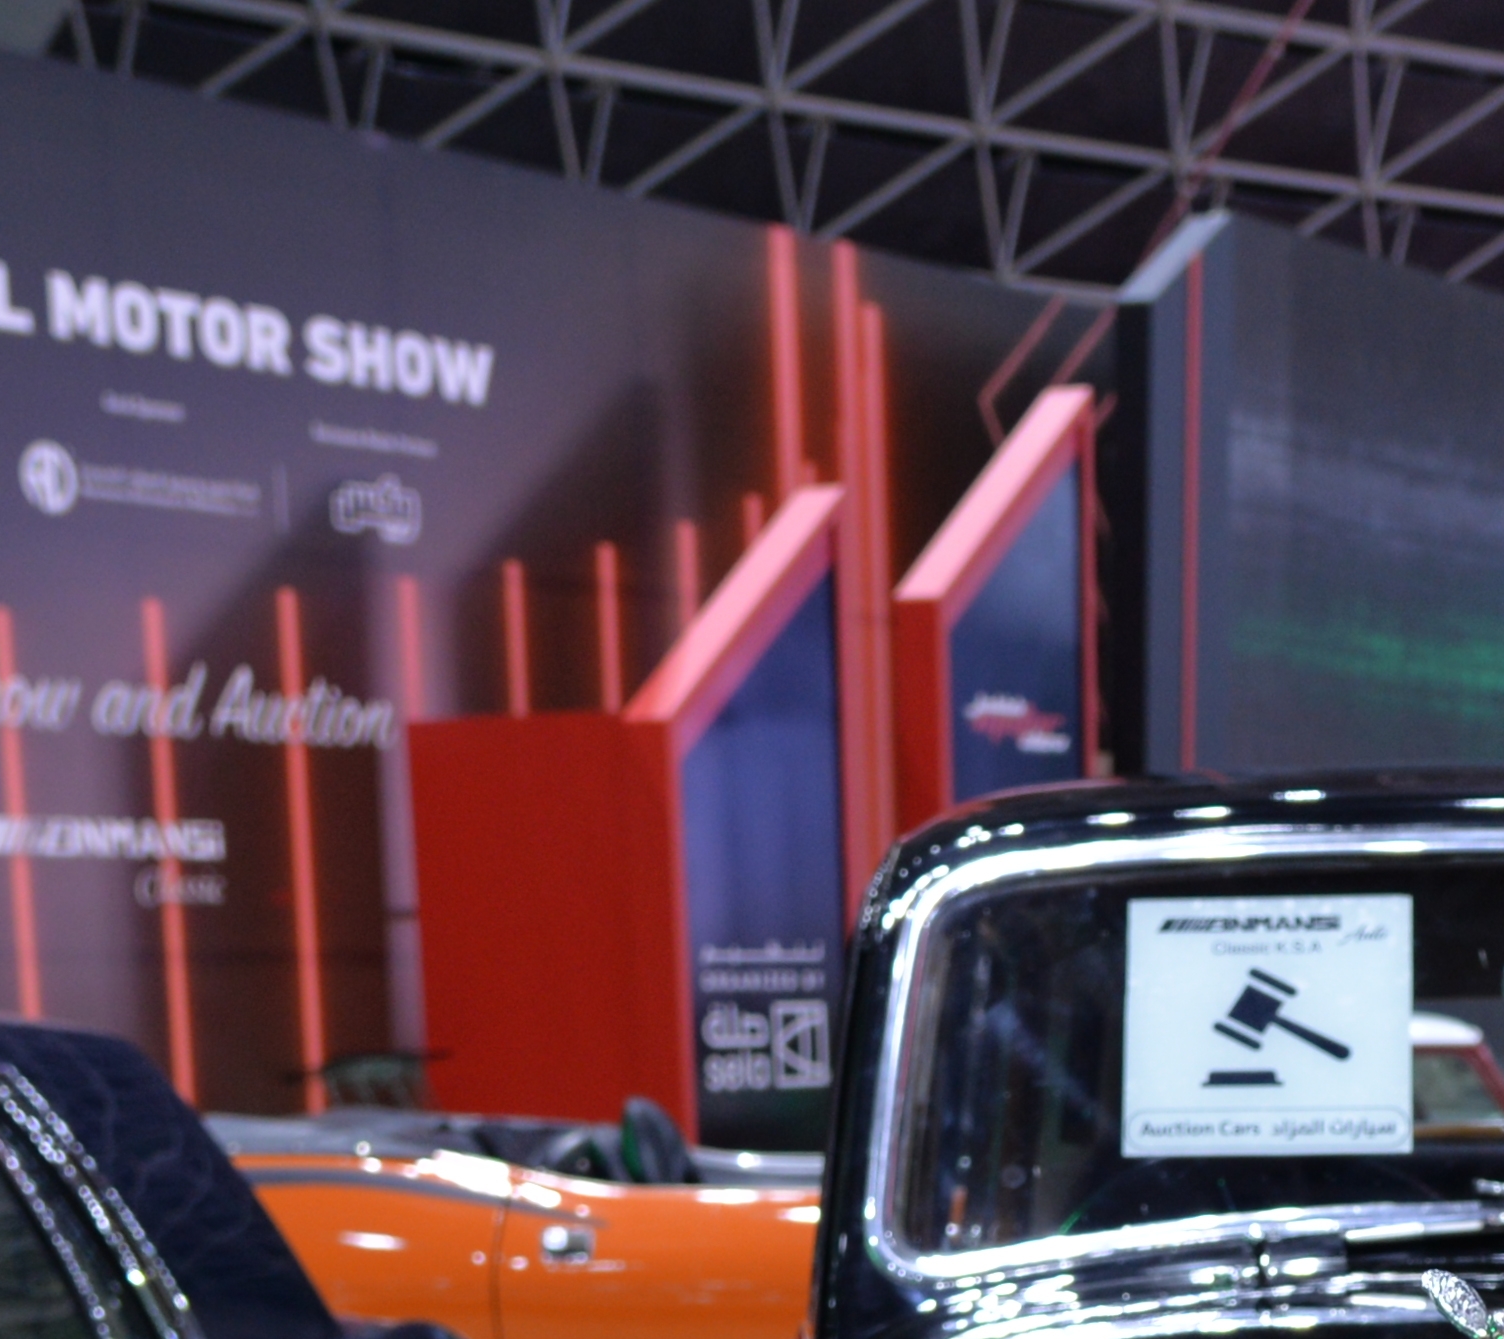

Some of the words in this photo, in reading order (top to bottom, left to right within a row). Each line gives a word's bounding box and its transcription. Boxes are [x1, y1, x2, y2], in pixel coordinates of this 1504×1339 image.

[45, 267, 293, 377] MOTOR
[303, 313, 494, 407] SHOW
[92, 660, 207, 740] and
[209, 662, 395, 751] Auction
[1140, 1119, 1214, 1137] Auction
[1218, 1119, 1261, 1137] Cars
